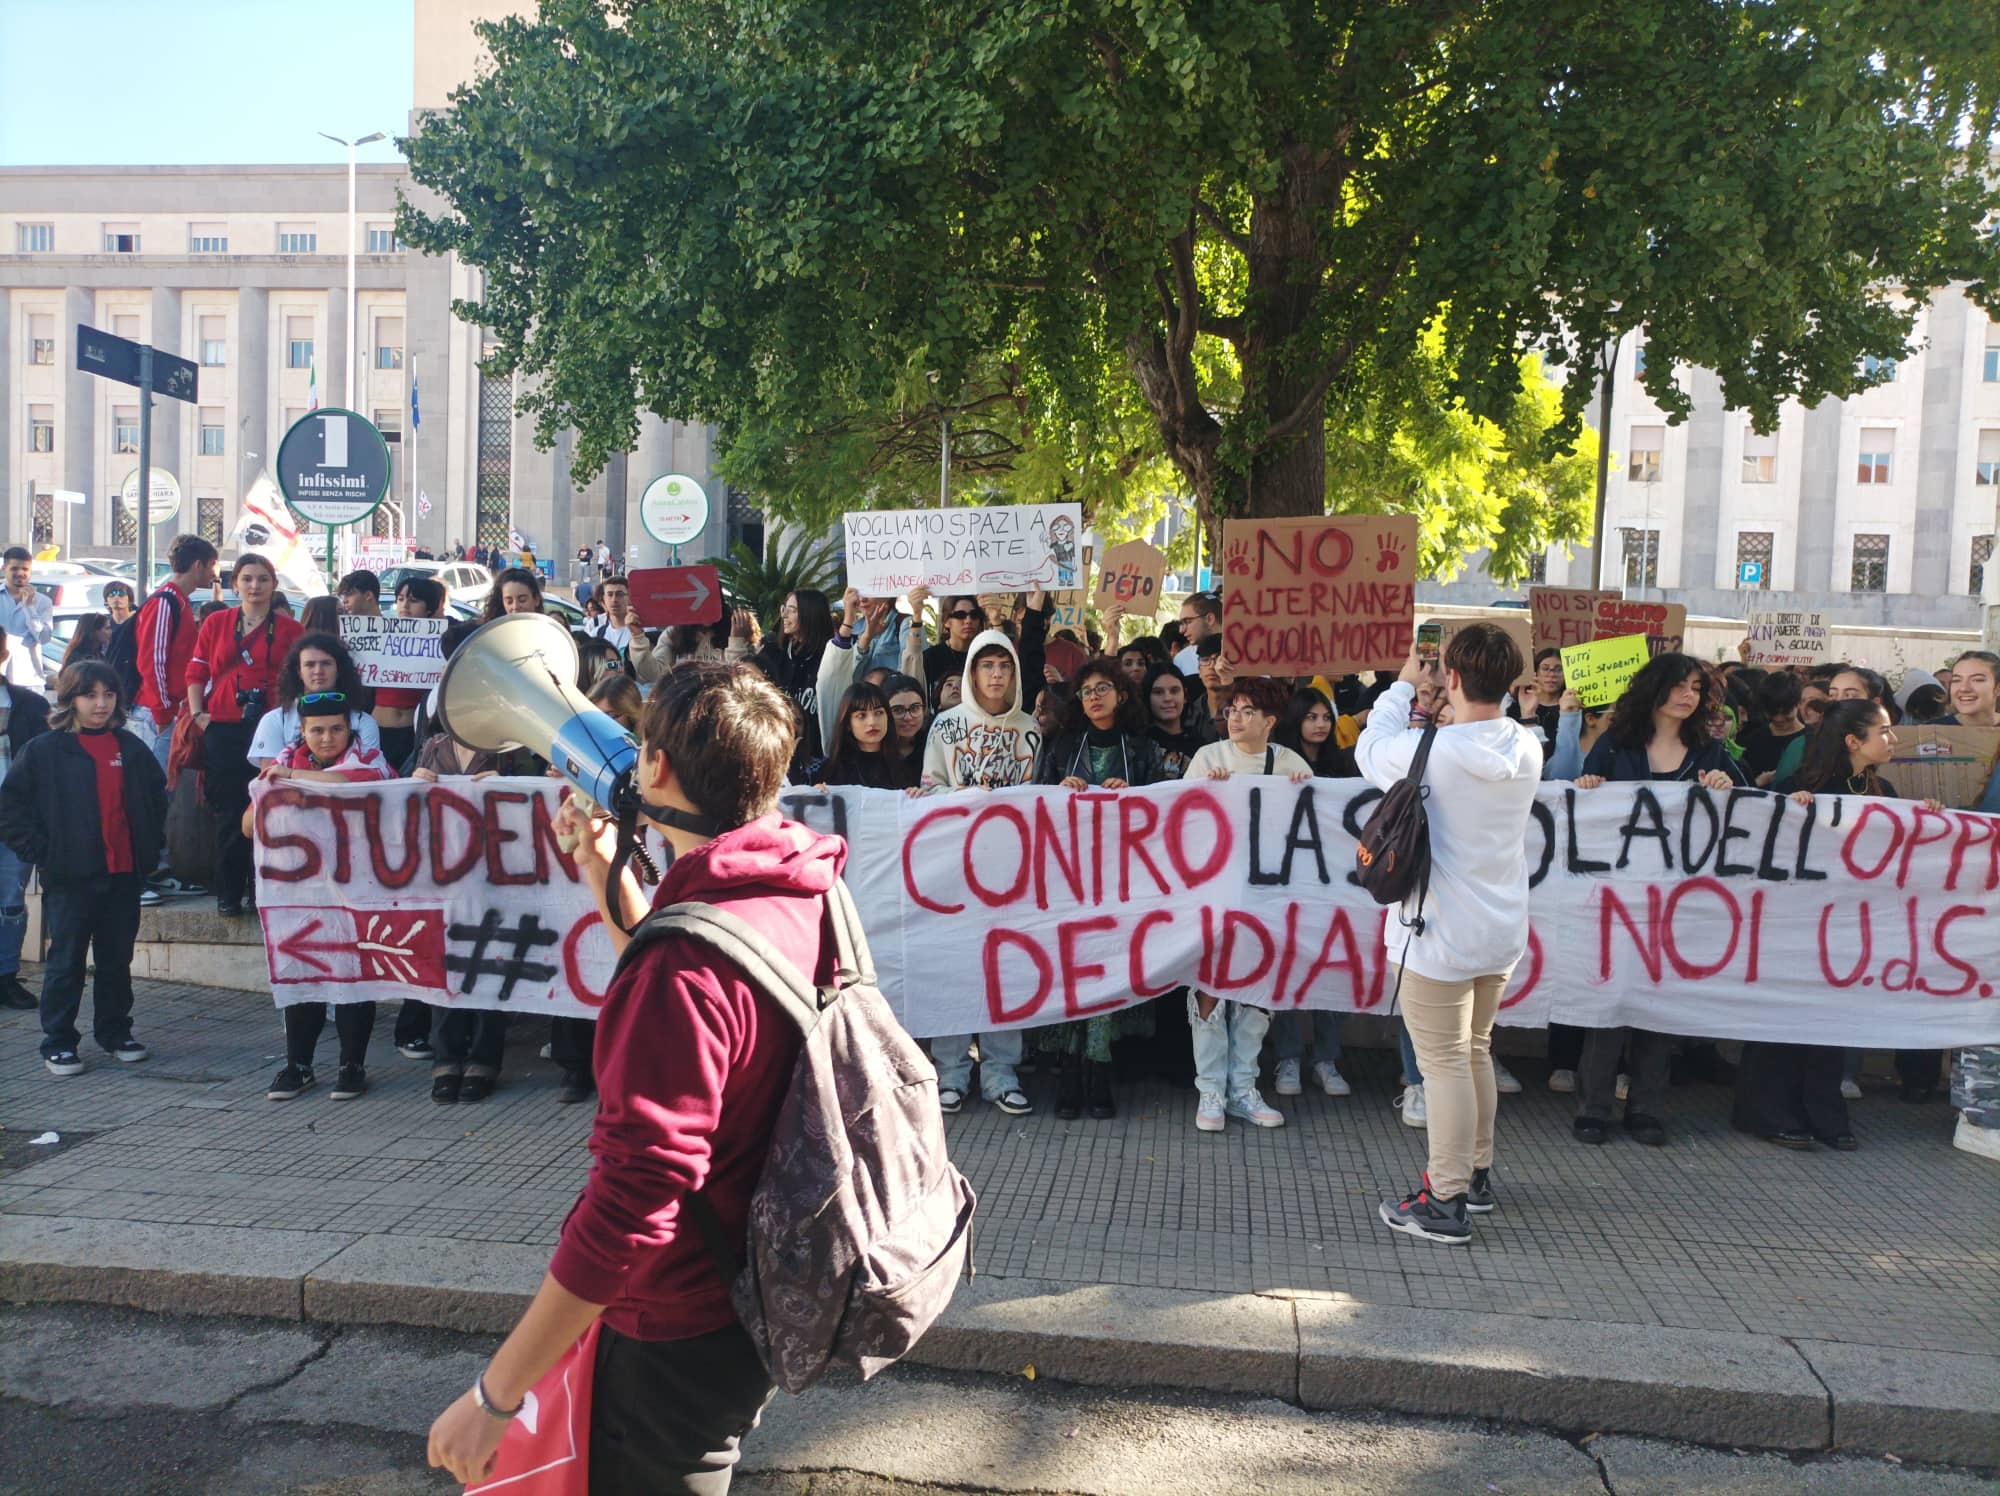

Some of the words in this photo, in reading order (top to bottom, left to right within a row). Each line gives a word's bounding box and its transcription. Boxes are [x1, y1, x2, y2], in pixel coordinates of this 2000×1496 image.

[298, 473, 367, 489] infissimi
[848, 513, 944, 537] VOGLIAMO
[950, 511, 1020, 537] SPAZI
[1030, 509, 1046, 531] A
[851, 541, 932, 565] REGOLA
[943, 538, 1025, 561] D'ARTE
[1255, 528, 1354, 581] NO
[1102, 570, 1153, 597] PCTO
[1744, 565, 1757, 580] P
[1223, 581, 1415, 617] ALTERNANZA
[1536, 593, 1569, 614] NOI
[341, 616, 360, 634] HO
[367, 617, 377, 634] IL
[428, 620, 441, 634] DI
[1774, 625, 1801, 637] AVERE
[1224, 621, 1328, 666] SCUOLA
[1329, 621, 1414, 663] MORTE
[902, 788, 1233, 914] CONTRO
[1249, 787, 1328, 886] LA
[1599, 876, 1764, 986] NOI
